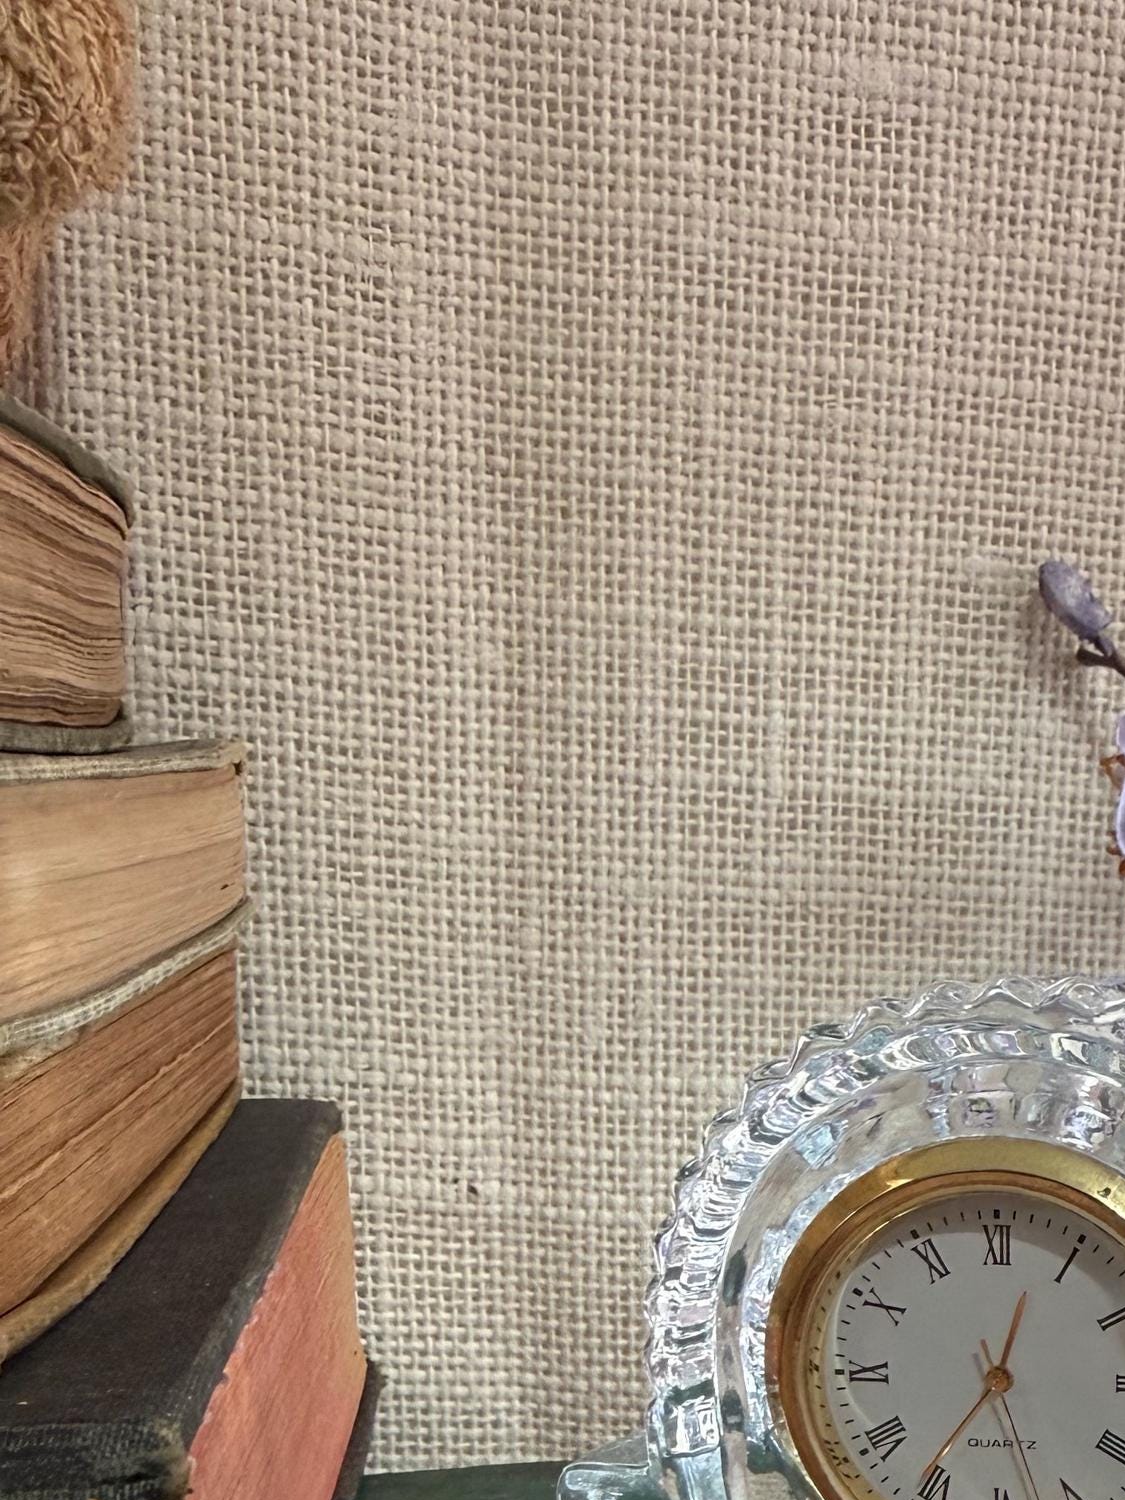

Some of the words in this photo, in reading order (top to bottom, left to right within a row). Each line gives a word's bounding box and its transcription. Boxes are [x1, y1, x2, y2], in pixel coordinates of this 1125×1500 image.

[911, 1238, 950, 1284] XI
[982, 1224, 1012, 1265] XII
[862, 1287, 907, 1326] X
[848, 1360, 889, 1385] IX
[864, 1415, 908, 1462] VIII
